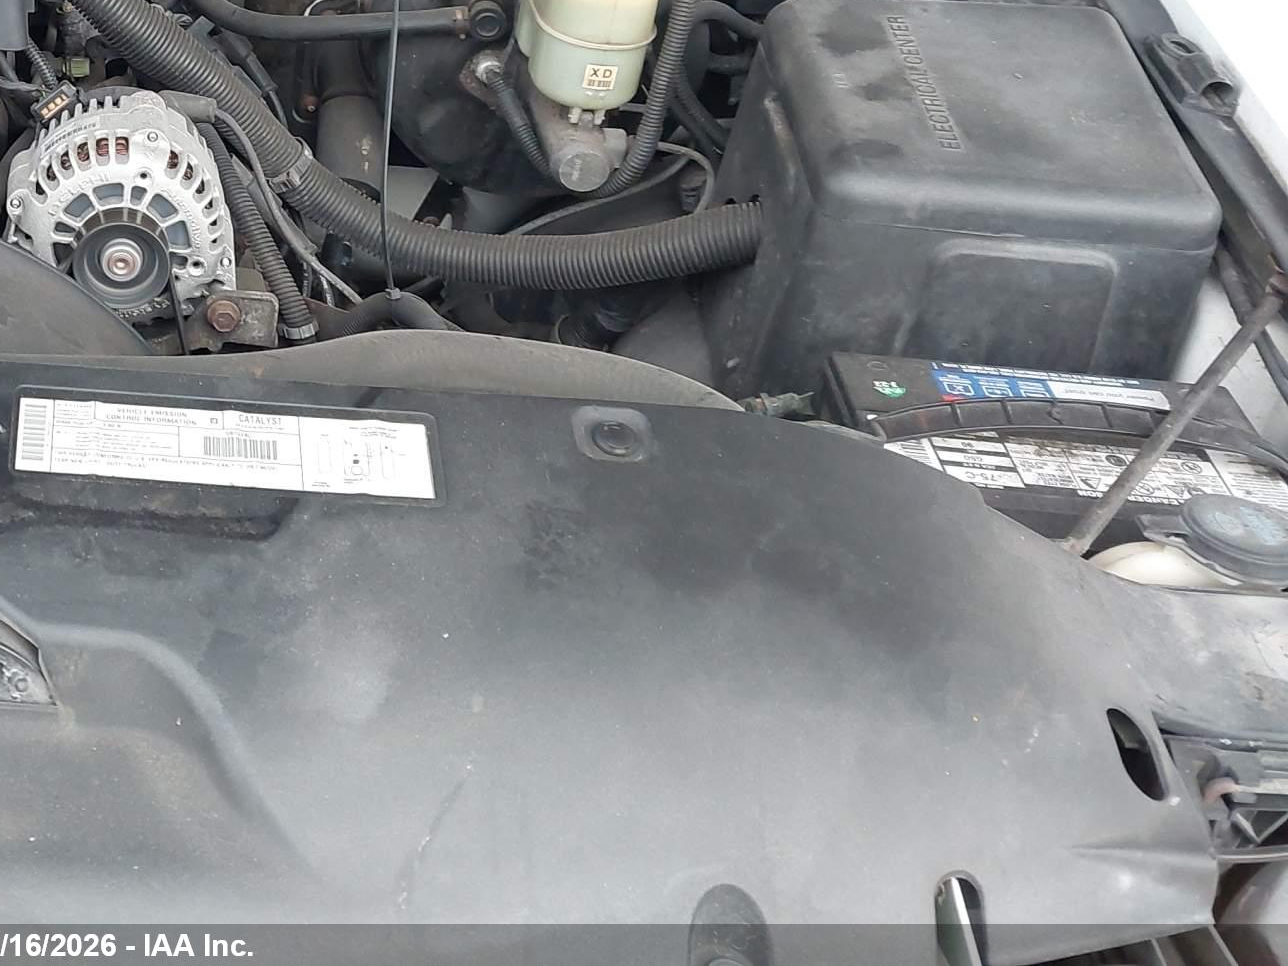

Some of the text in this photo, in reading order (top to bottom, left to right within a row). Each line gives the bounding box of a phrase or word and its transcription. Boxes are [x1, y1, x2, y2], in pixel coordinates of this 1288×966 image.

[886, 15, 962, 151] ELECTRICAL CENTER
[238, 413, 283, 426] CATALYST
